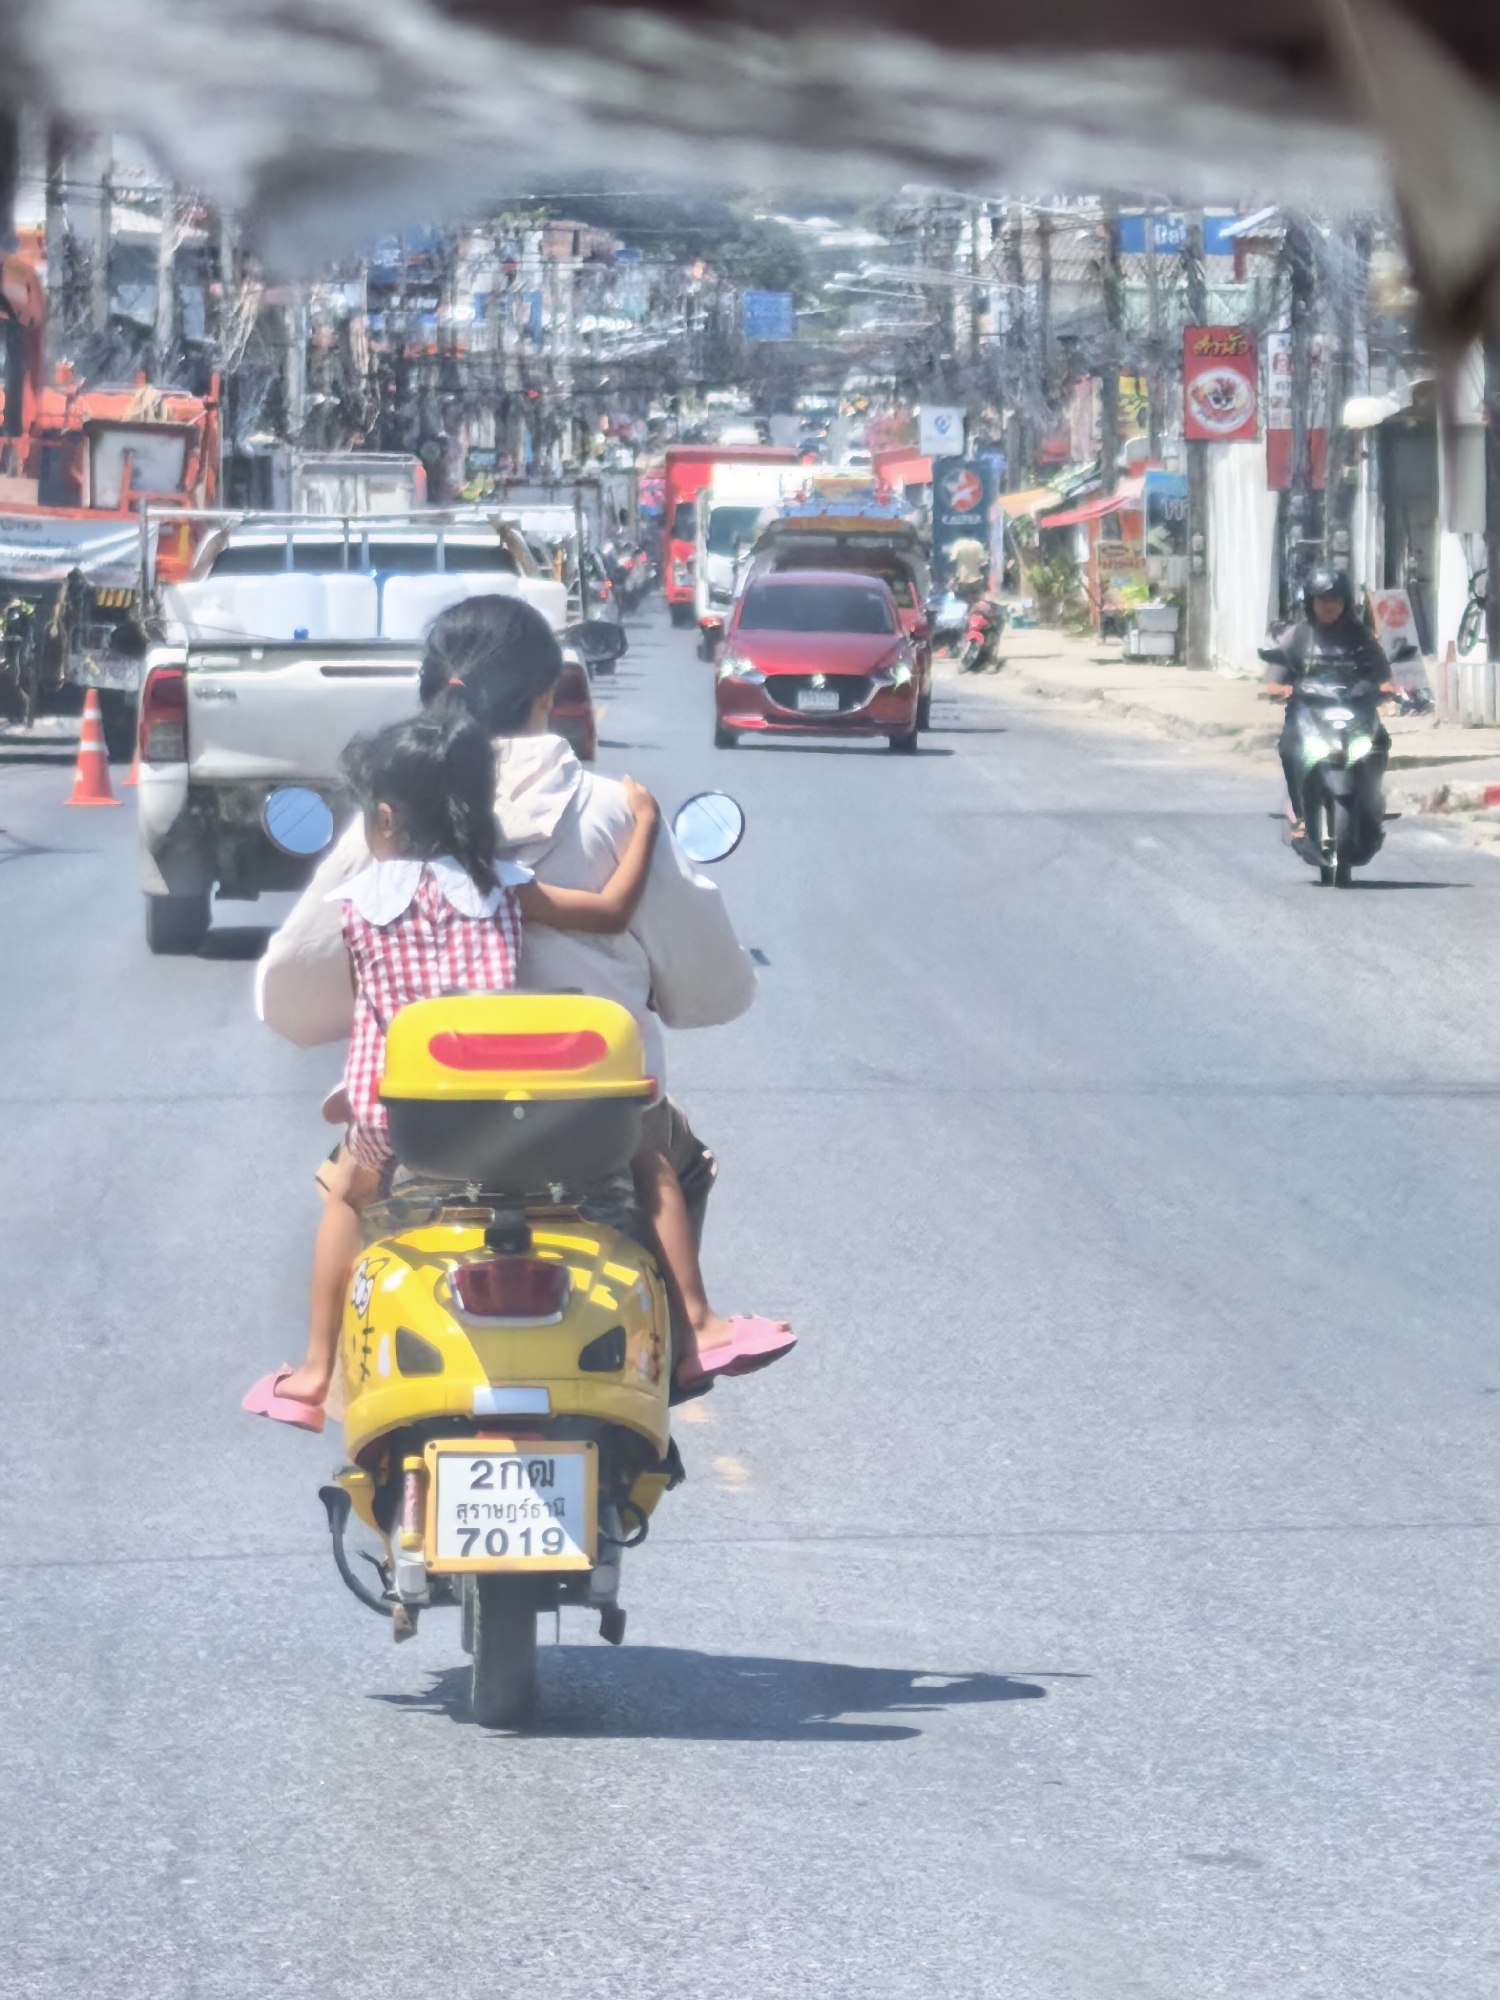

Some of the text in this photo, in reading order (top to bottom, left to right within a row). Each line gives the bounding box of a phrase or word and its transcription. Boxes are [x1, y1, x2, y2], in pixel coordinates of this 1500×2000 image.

[456, 1497, 565, 1525] สุราษฎร์ธานี
[456, 1526, 565, 1557] 7019
